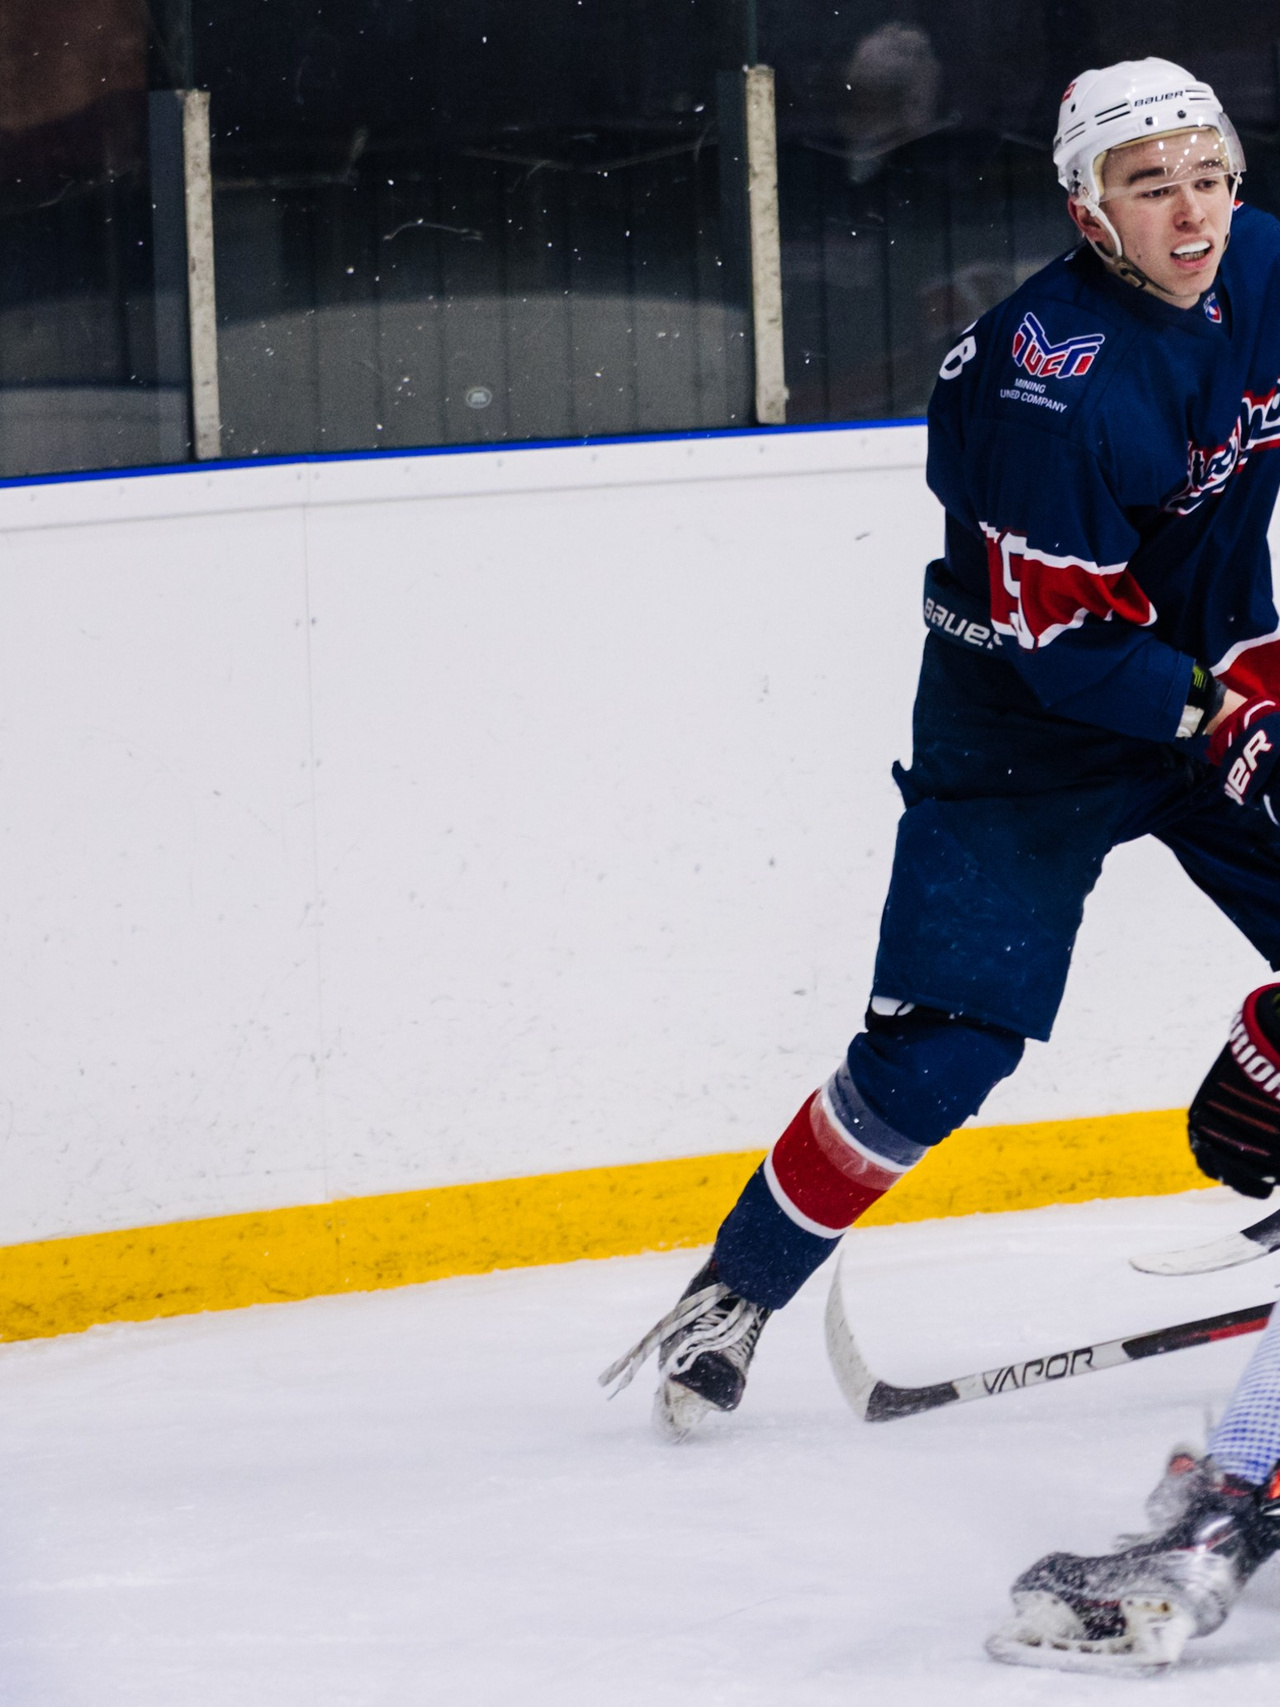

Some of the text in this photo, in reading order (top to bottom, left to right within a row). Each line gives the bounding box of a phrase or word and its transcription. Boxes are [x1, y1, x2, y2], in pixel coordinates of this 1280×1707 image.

[1014, 377, 1046, 394] MINING
[1020, 391, 1068, 413] COMPANY
[982, 1346, 1096, 1396] VAPOR
